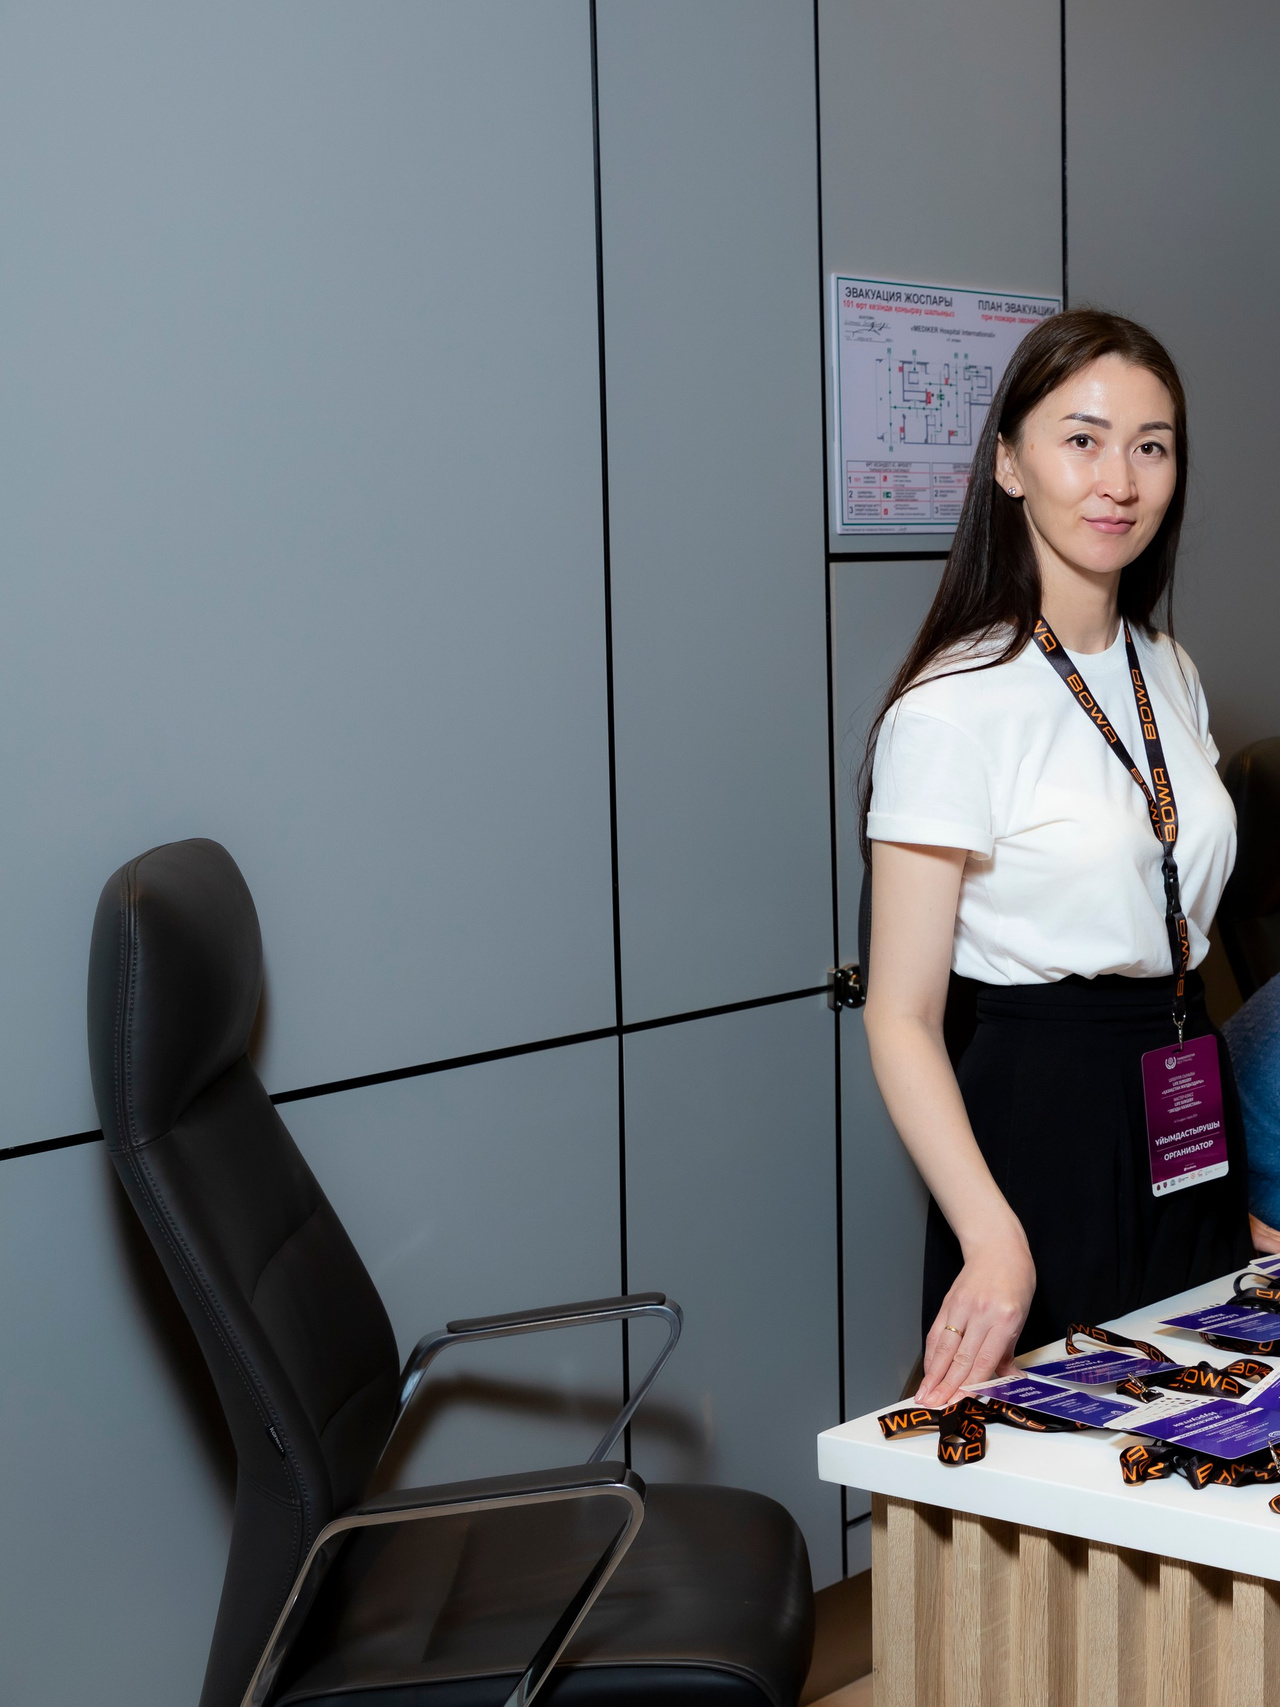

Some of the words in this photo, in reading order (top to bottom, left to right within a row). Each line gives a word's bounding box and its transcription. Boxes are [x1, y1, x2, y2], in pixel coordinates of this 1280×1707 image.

[843, 299, 854, 308] 101
[845, 286, 902, 303] ЭВАКУАЦИЯ
[904, 292, 953, 307] ЖОСПАРЫ
[978, 299, 1003, 312] ПЛАН
[1004, 302, 1056, 317] ЭВАКУАЦИИ
[848, 476, 852, 484] 1
[848, 490, 853, 499] 2
[934, 489, 939, 498] 2
[848, 505, 854, 514] 3
[1066, 673, 1118, 744] BOWA
[1131, 668, 1157, 740] BOWA
[1153, 767, 1176, 842] BOWA
[1163, 1139, 1214, 1161] ОРГАНИЗАТОР
